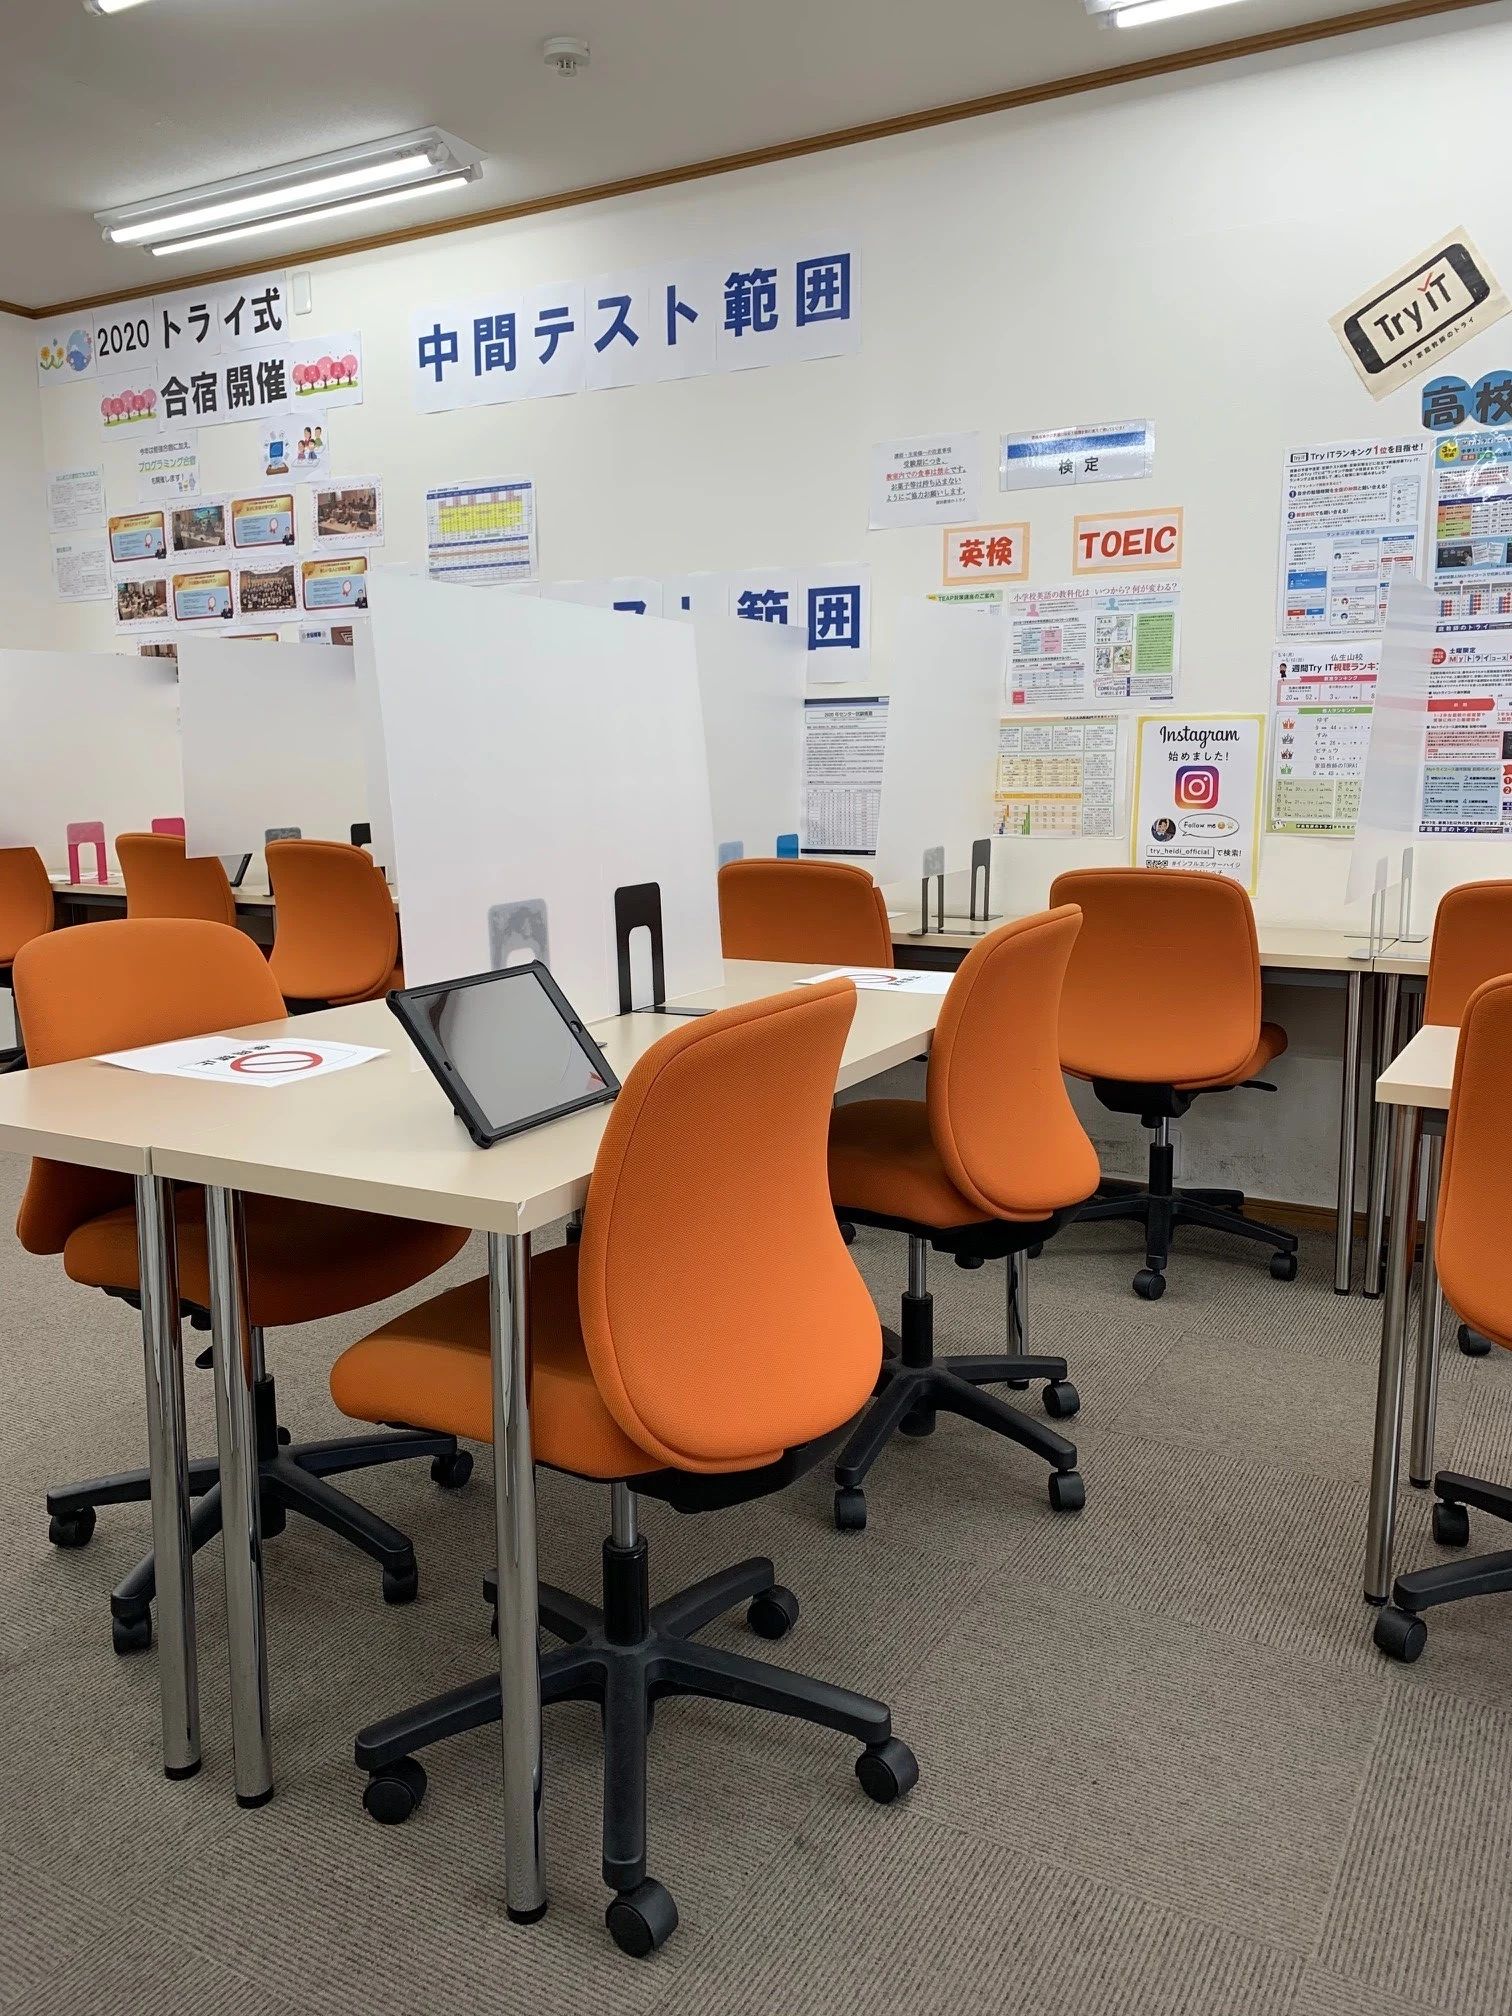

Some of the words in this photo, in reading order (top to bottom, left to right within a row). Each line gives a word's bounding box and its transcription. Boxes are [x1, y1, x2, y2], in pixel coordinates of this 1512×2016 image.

[98, 318, 150, 357] 2020
[162, 287, 283, 348] トライ式
[418, 252, 851, 382] 中間テスト範囲
[1373, 297, 1423, 342] Try
[1058, 456, 1099, 475] 検定
[1311, 453, 1326, 461] Try
[959, 536, 1013, 568] 英検
[1079, 524, 1177, 560] TOEIC
[1331, 653, 1363, 662] 仏生山校
[1160, 725, 1240, 749] Instagram
[1168, 751, 1229, 762] 始めました!
[1183, 821, 1205, 829] Follow
[1150, 847, 1210, 857] try_heidi_official
